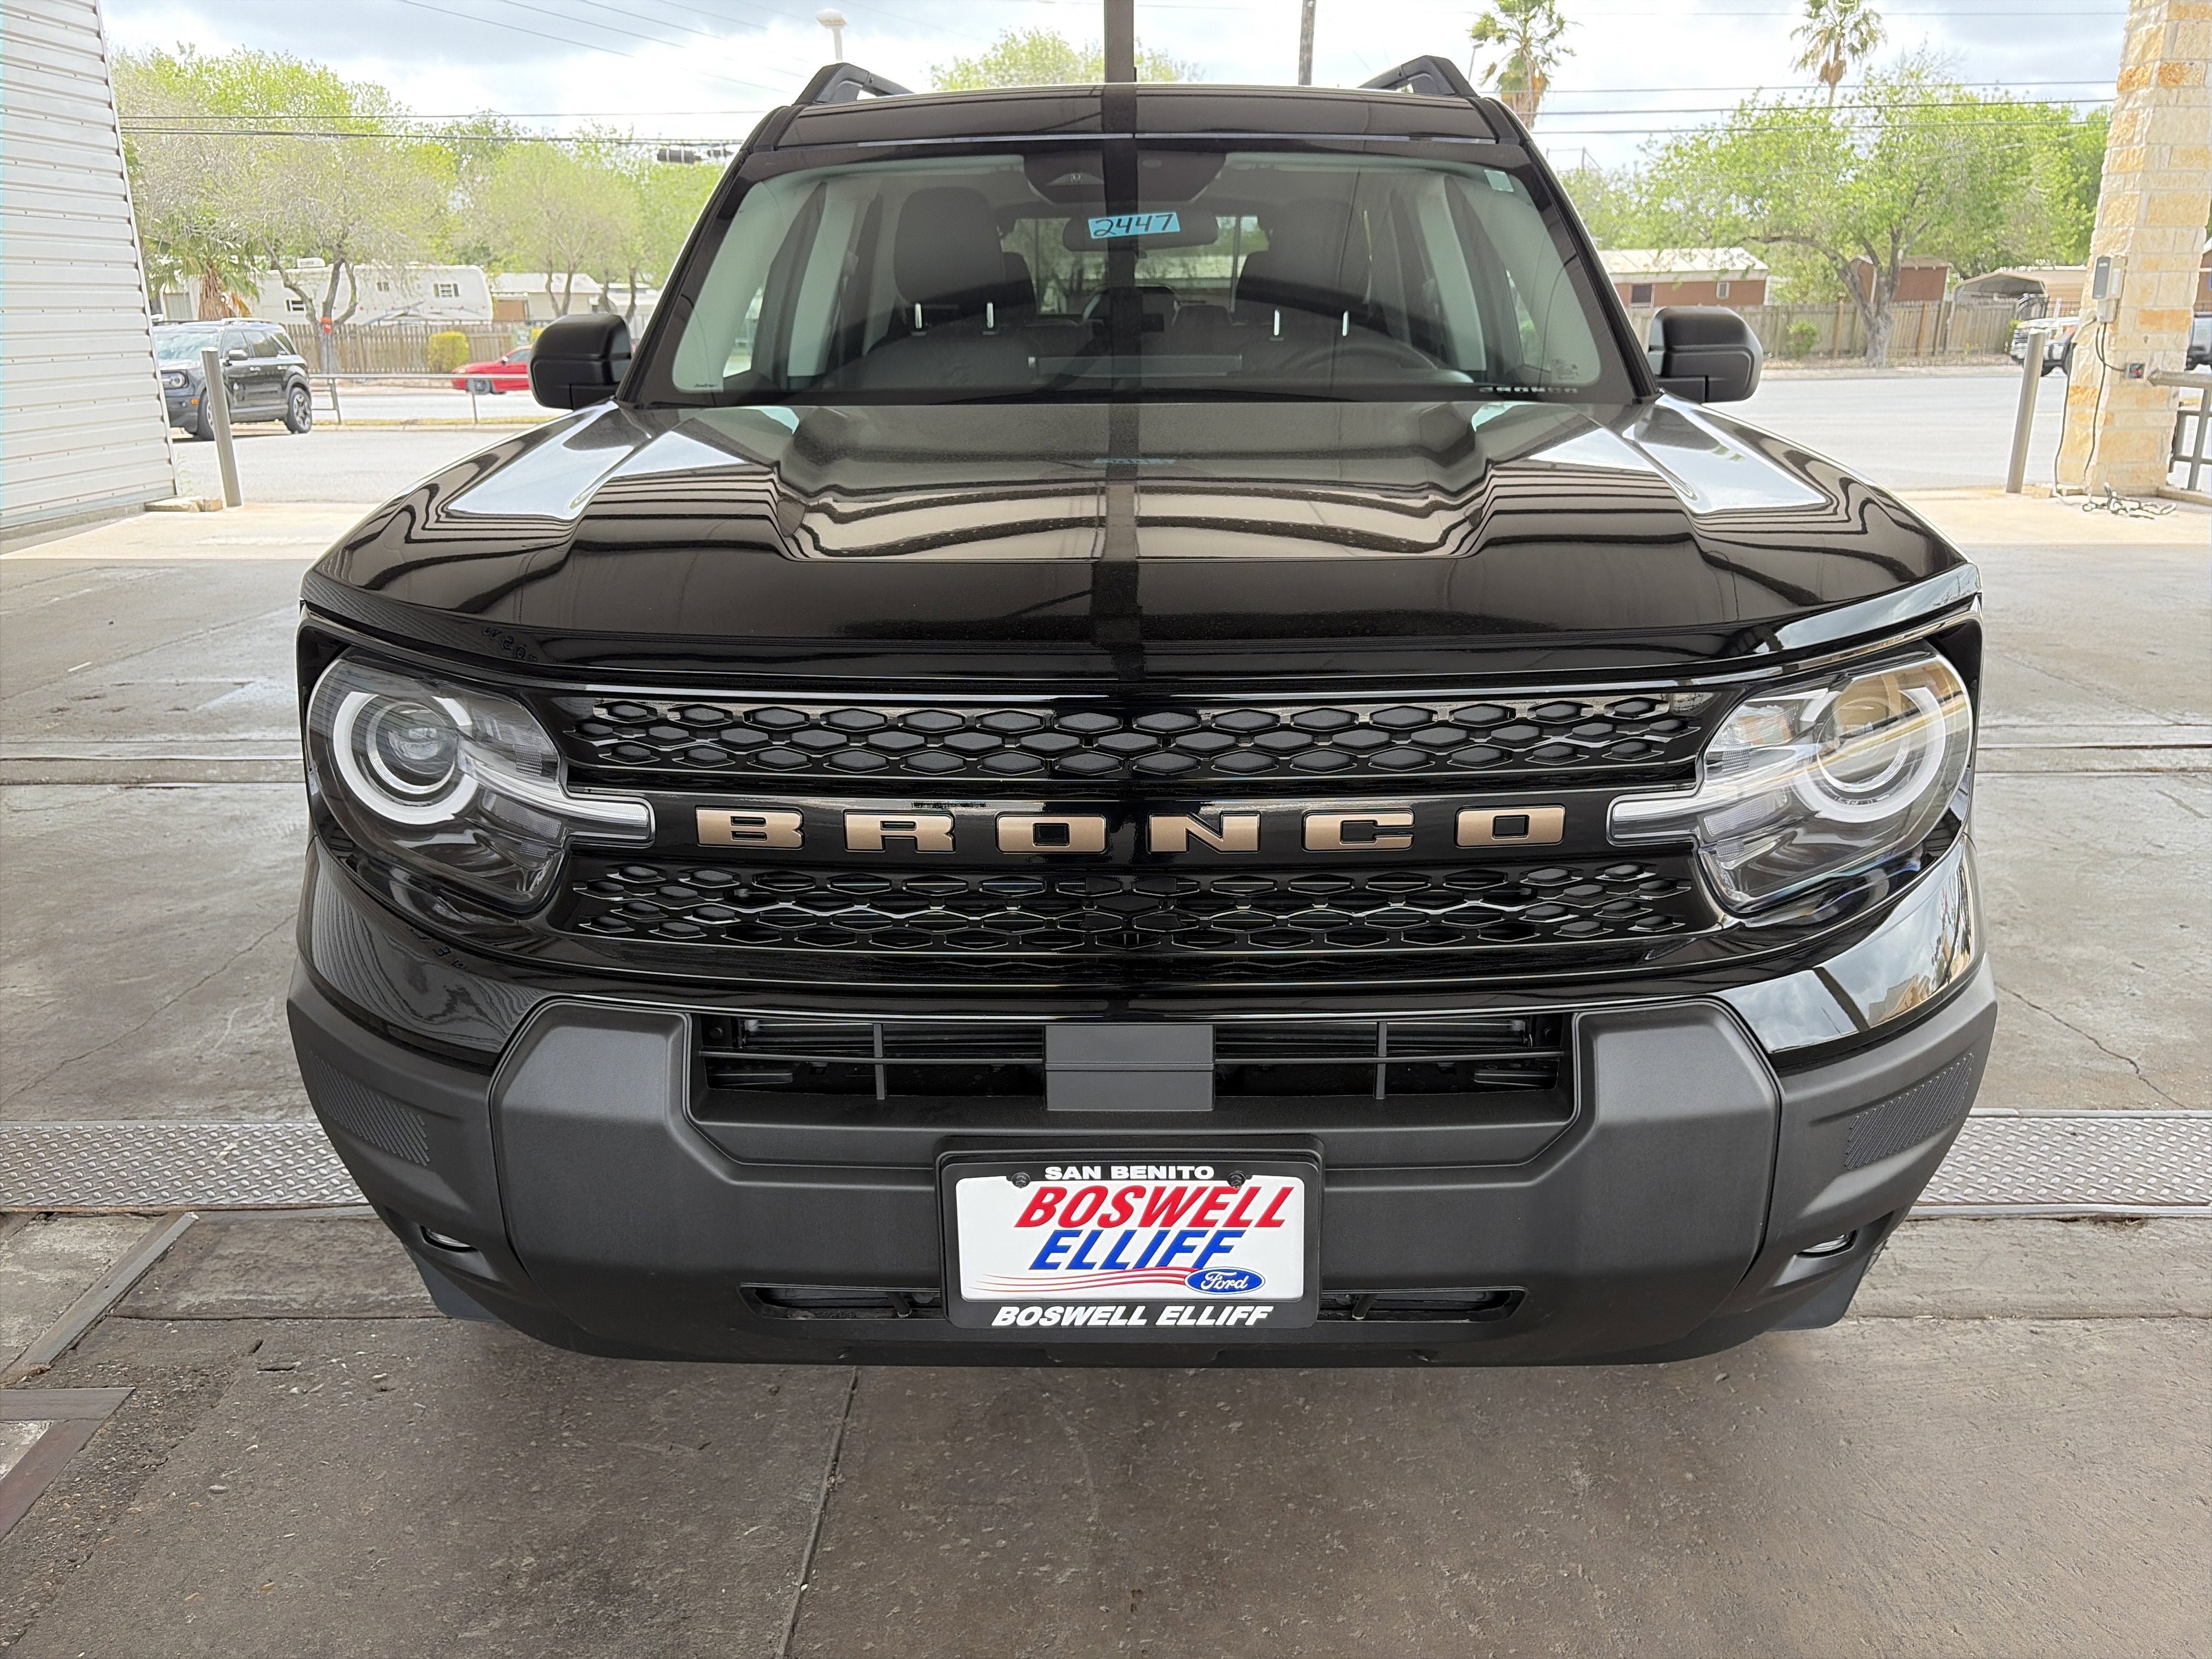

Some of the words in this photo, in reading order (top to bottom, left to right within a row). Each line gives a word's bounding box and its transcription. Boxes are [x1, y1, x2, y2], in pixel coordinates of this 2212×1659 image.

[1093, 214, 1173, 237] 2447
[695, 805, 1567, 854] BRONCO
[1045, 1166, 1101, 1180] SAN
[1111, 1166, 1214, 1180] BENITO
[1014, 1185, 1294, 1228] BOSWELL
[1029, 1229, 1247, 1270] ELLIFF
[1200, 1271, 1248, 1290] Ford
[991, 1306, 1146, 1326] BOSWELL
[1155, 1306, 1274, 1325] ELLIFF
